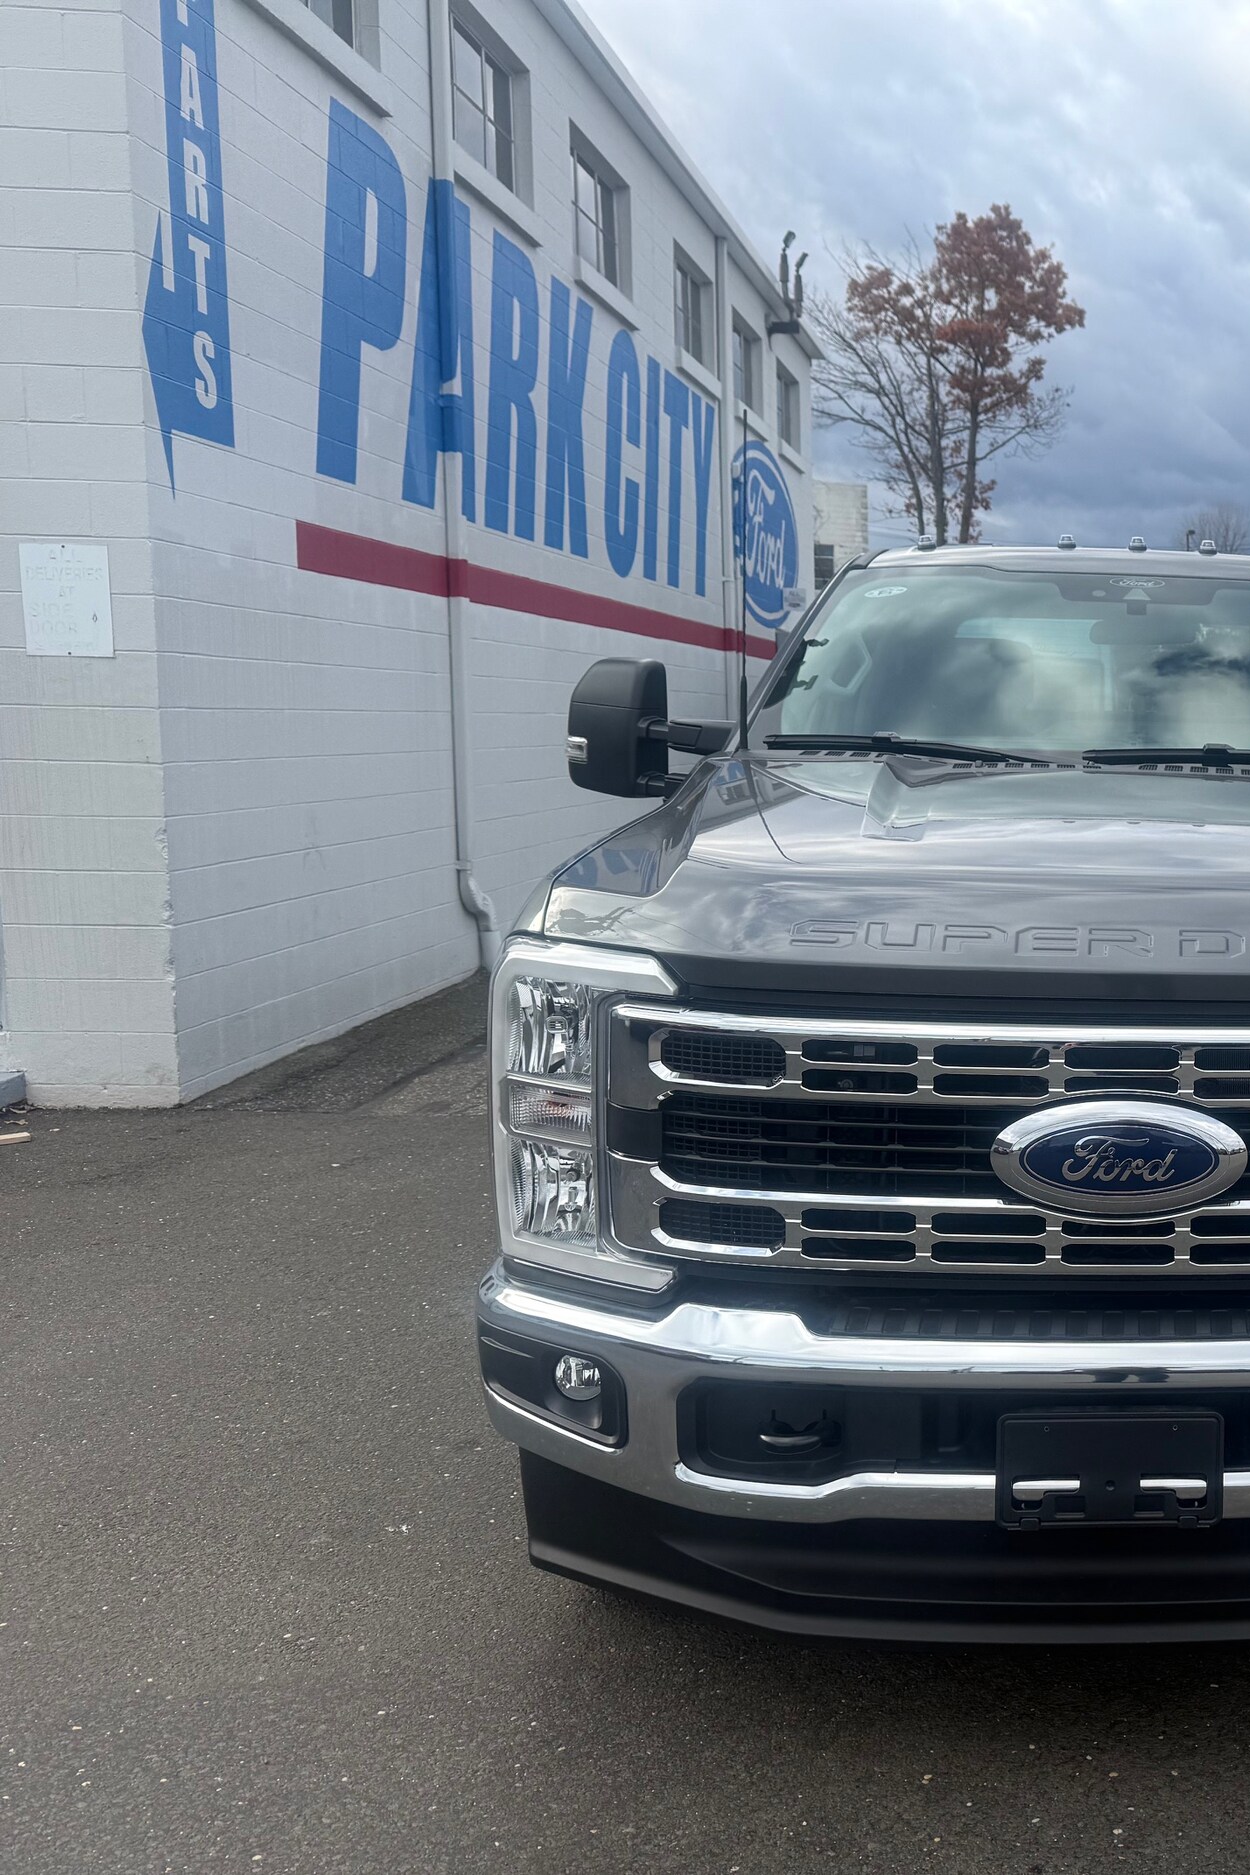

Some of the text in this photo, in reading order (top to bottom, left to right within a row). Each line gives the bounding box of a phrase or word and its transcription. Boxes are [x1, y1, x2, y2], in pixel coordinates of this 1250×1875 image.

[315, 95, 715, 598] PARK CITY
[745, 468, 786, 590] Ford
[788, 919, 1157, 958] SUPER
[1060, 1134, 1179, 1183] Ford
